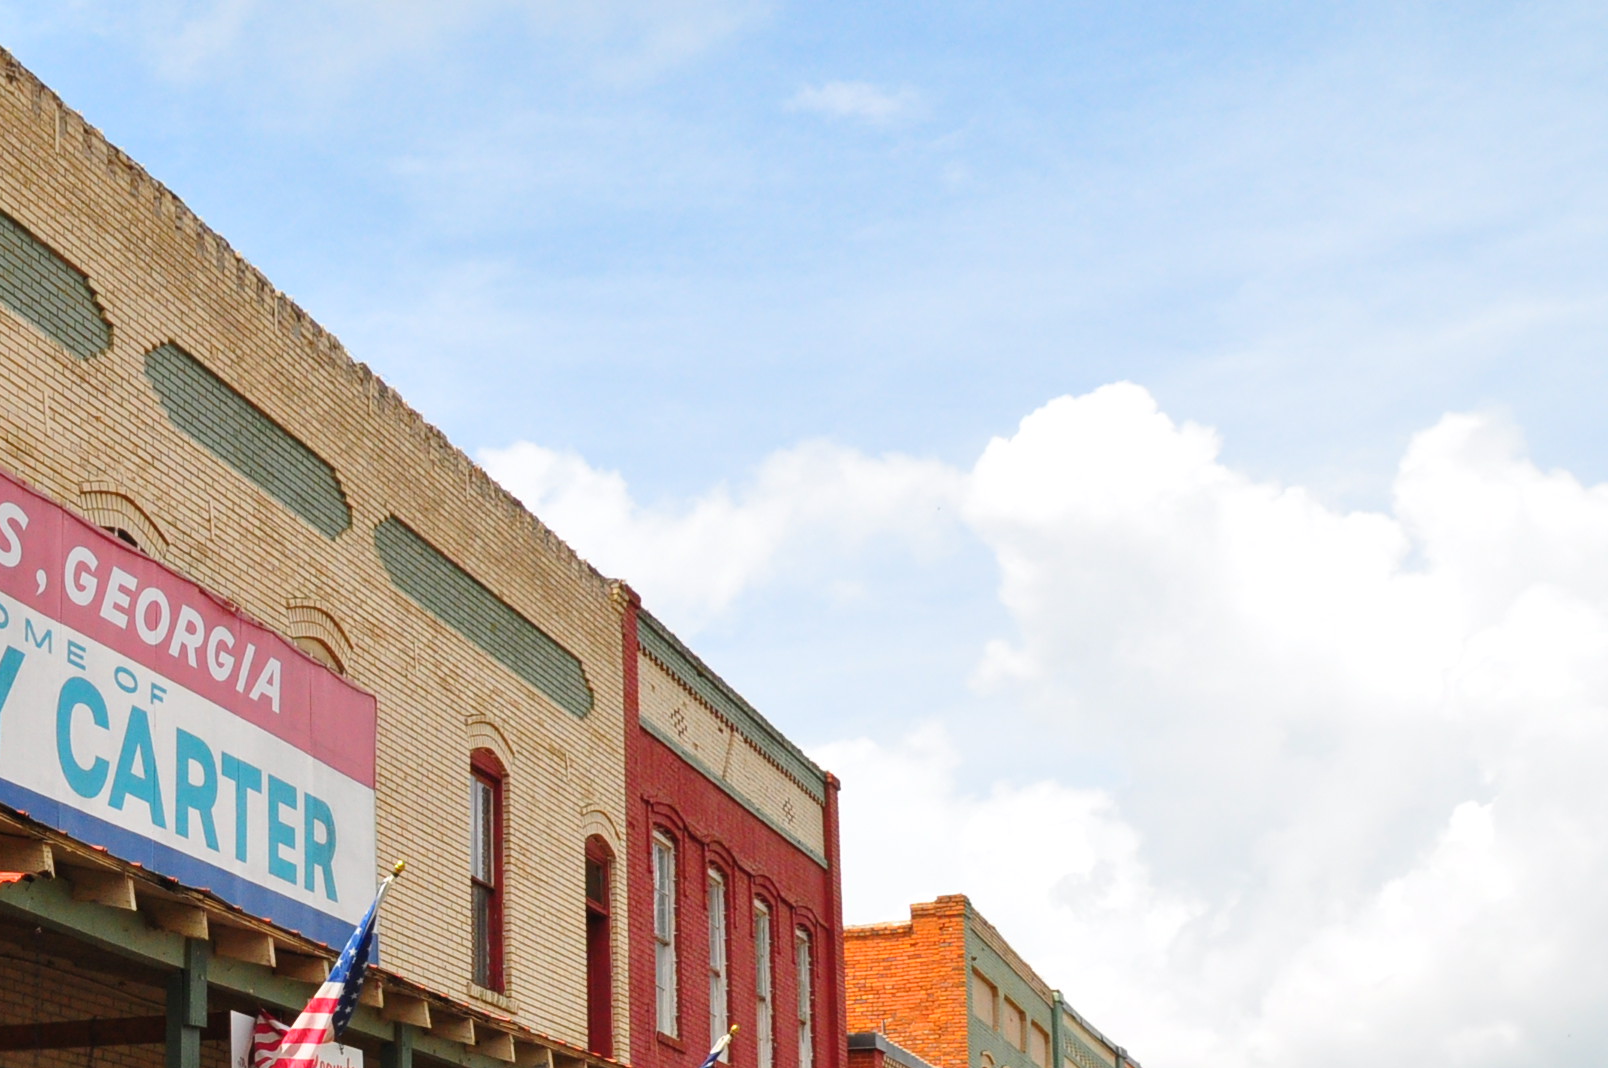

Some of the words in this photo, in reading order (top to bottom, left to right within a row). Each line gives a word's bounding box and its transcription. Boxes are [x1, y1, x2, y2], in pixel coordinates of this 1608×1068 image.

[62, 546, 282, 714] GEORGIA
[114, 666, 167, 705] OF
[56, 675, 339, 902] CARTER
